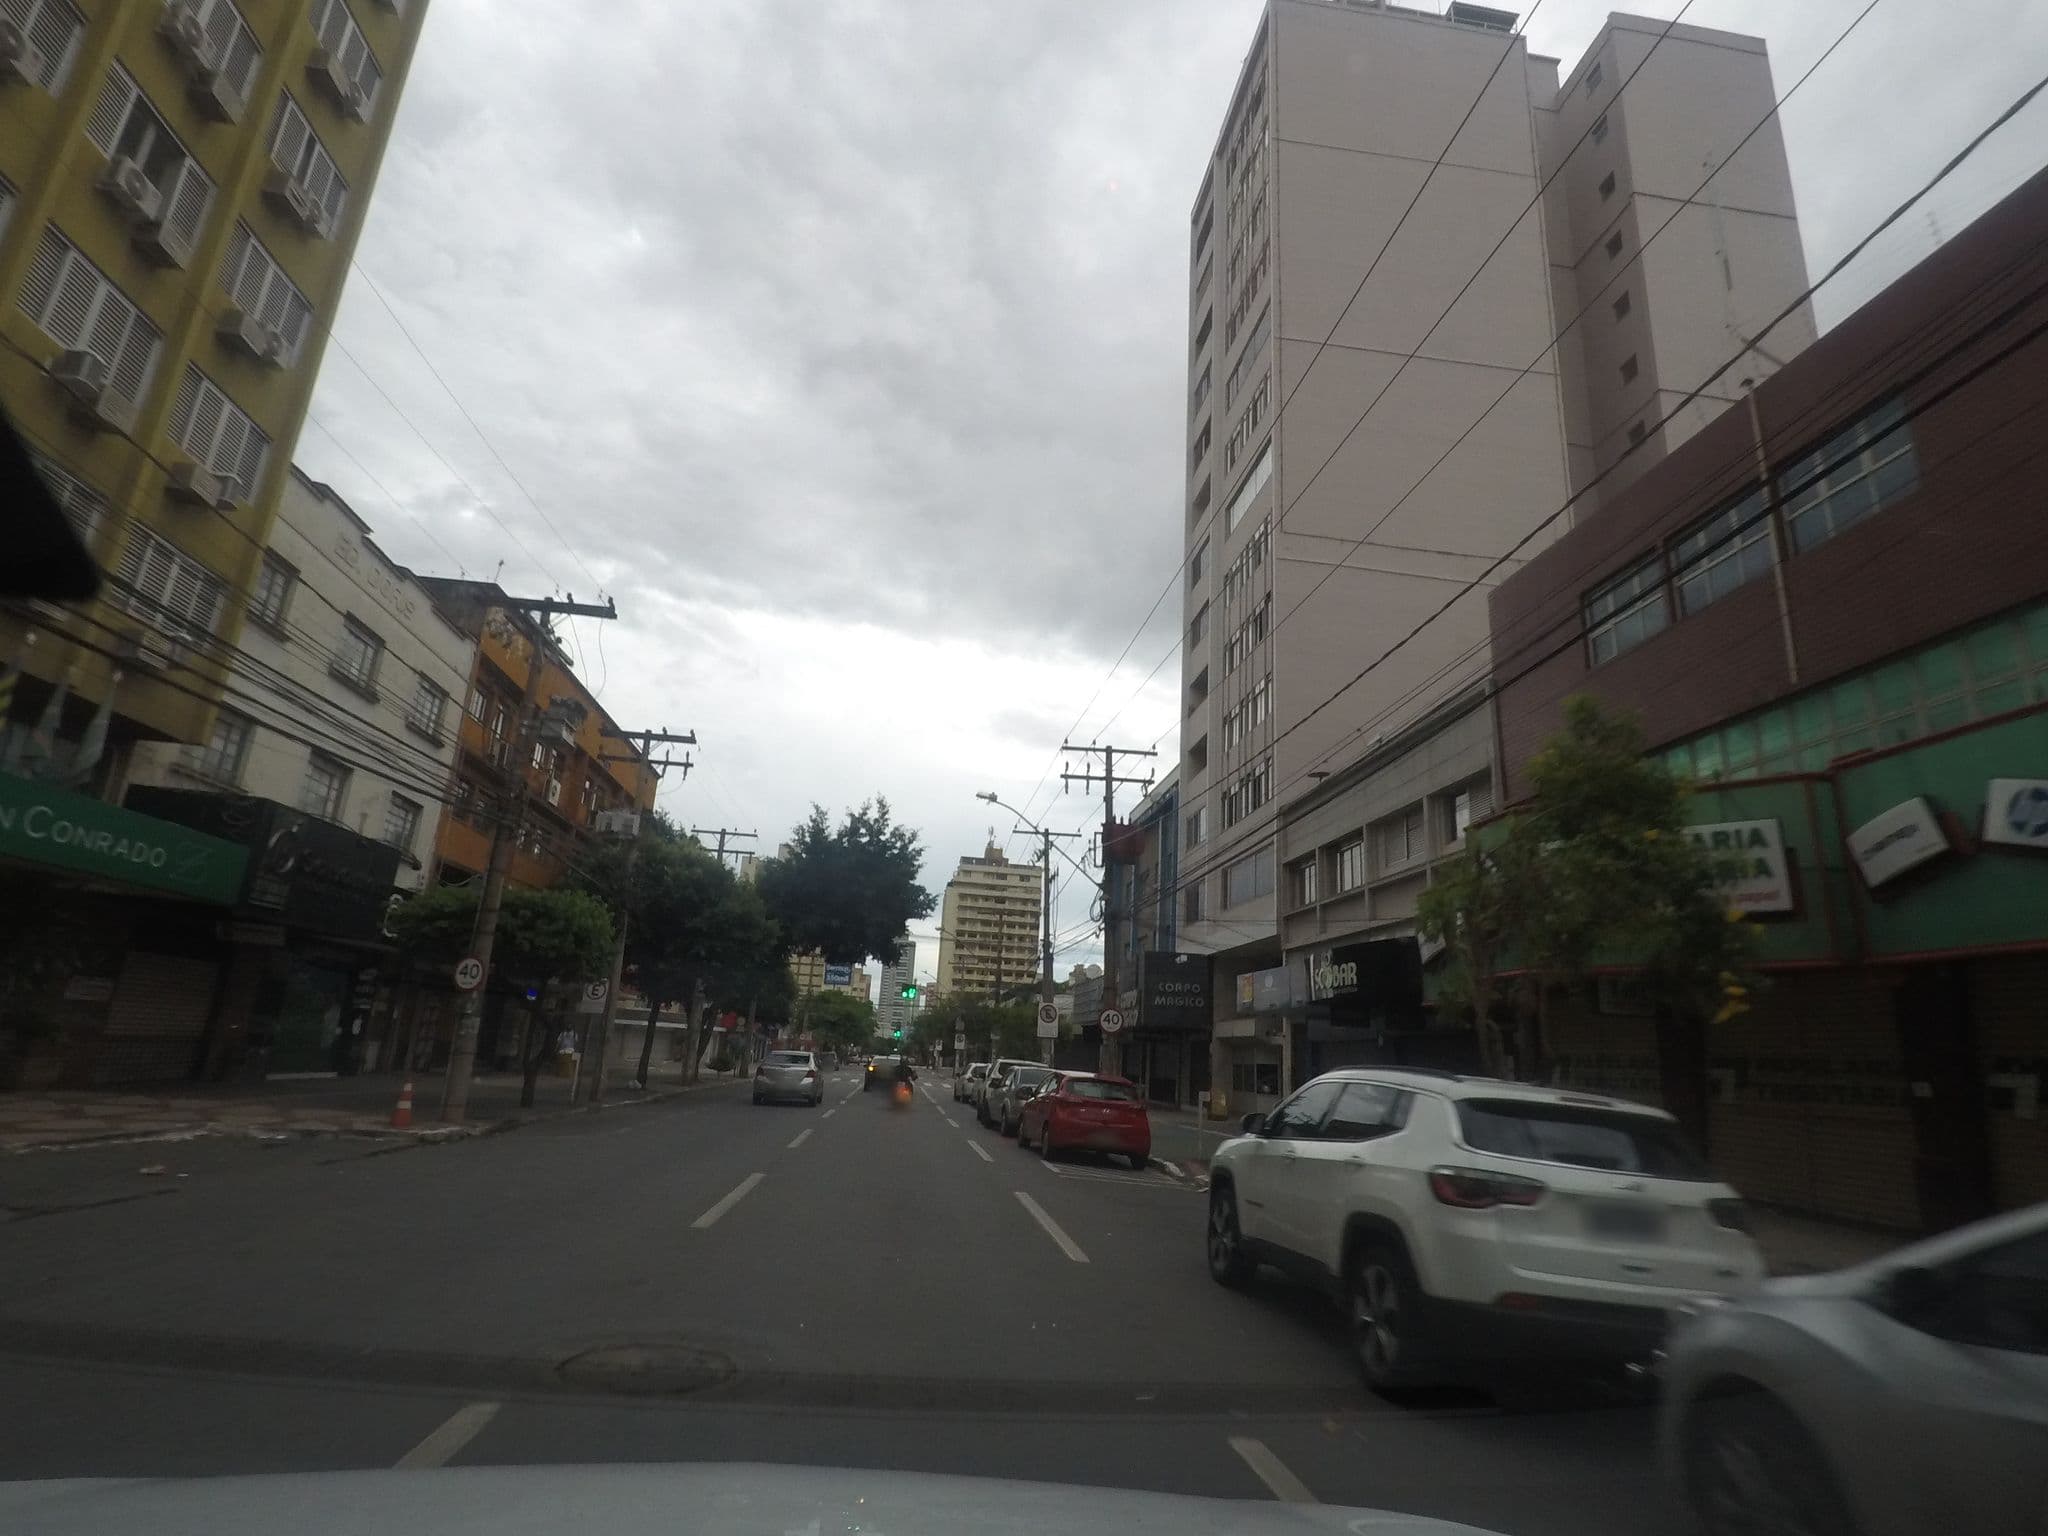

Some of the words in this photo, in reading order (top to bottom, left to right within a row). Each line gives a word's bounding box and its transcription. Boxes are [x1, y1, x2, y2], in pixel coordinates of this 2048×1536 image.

[22, 804, 168, 868] CONRADO
[459, 963, 480, 979] 40
[1158, 982, 1201, 994] CORPO
[1103, 1013, 1120, 1026] 40
